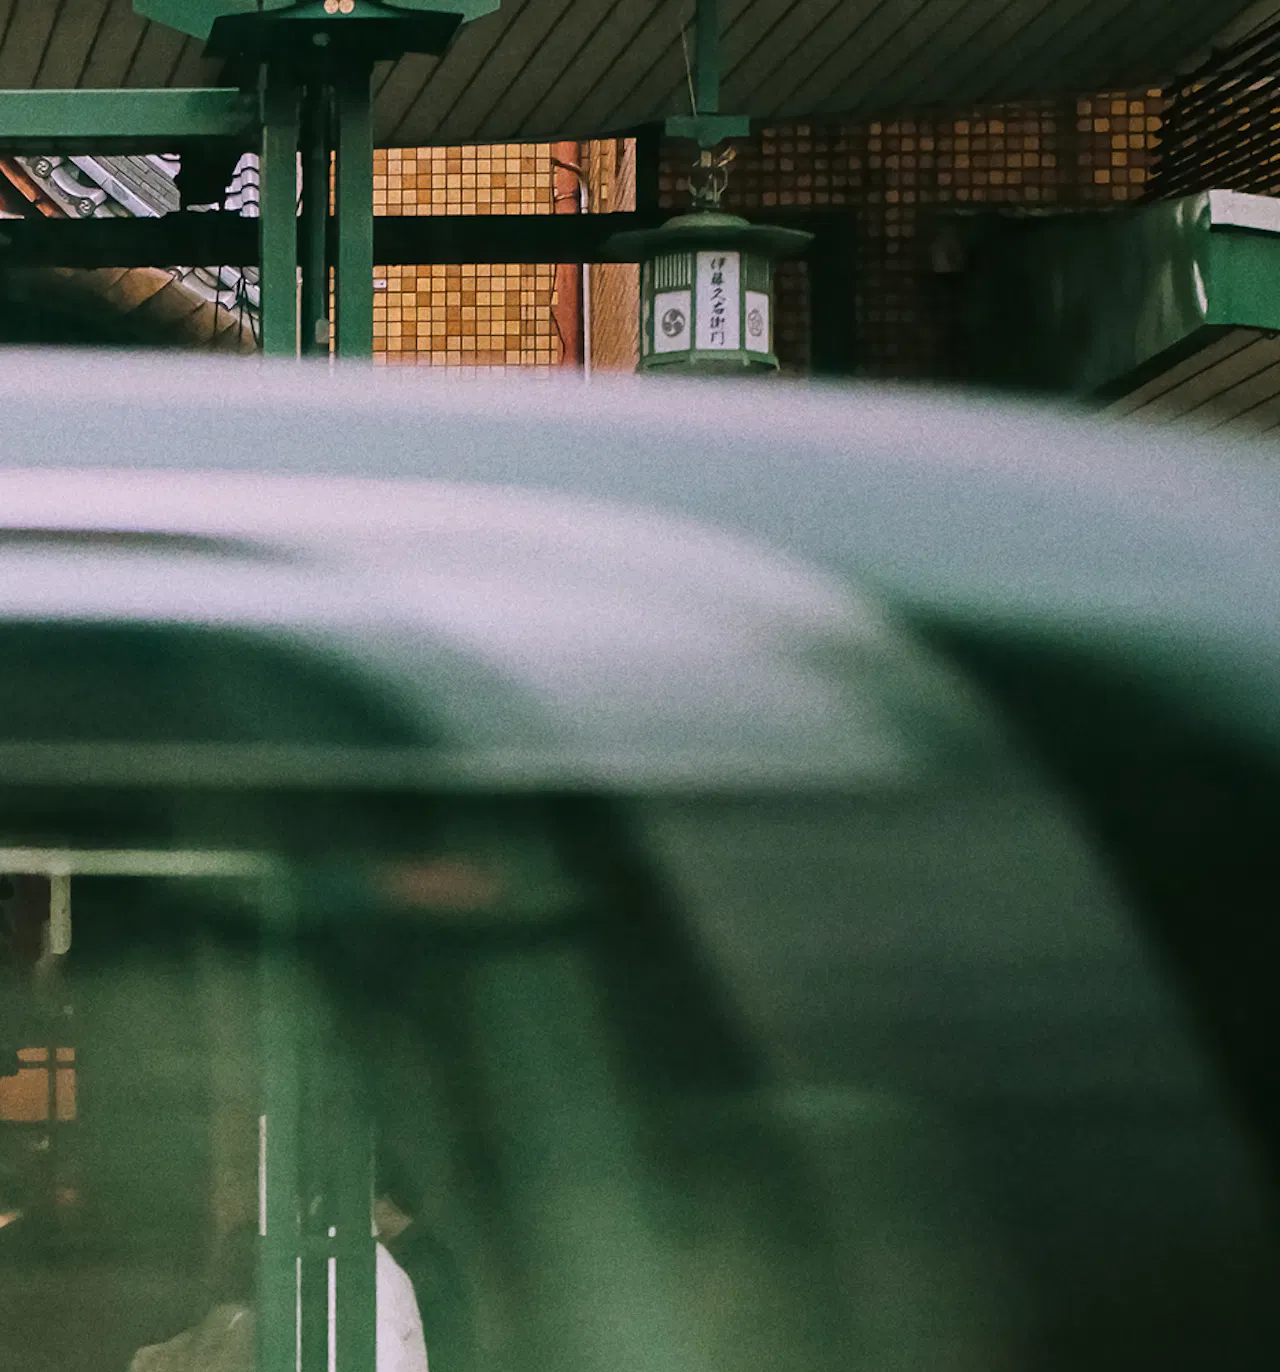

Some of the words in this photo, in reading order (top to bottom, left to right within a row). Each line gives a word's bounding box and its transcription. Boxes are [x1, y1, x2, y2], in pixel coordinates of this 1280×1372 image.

[709, 257, 726, 346] 伊藤久右衛門
